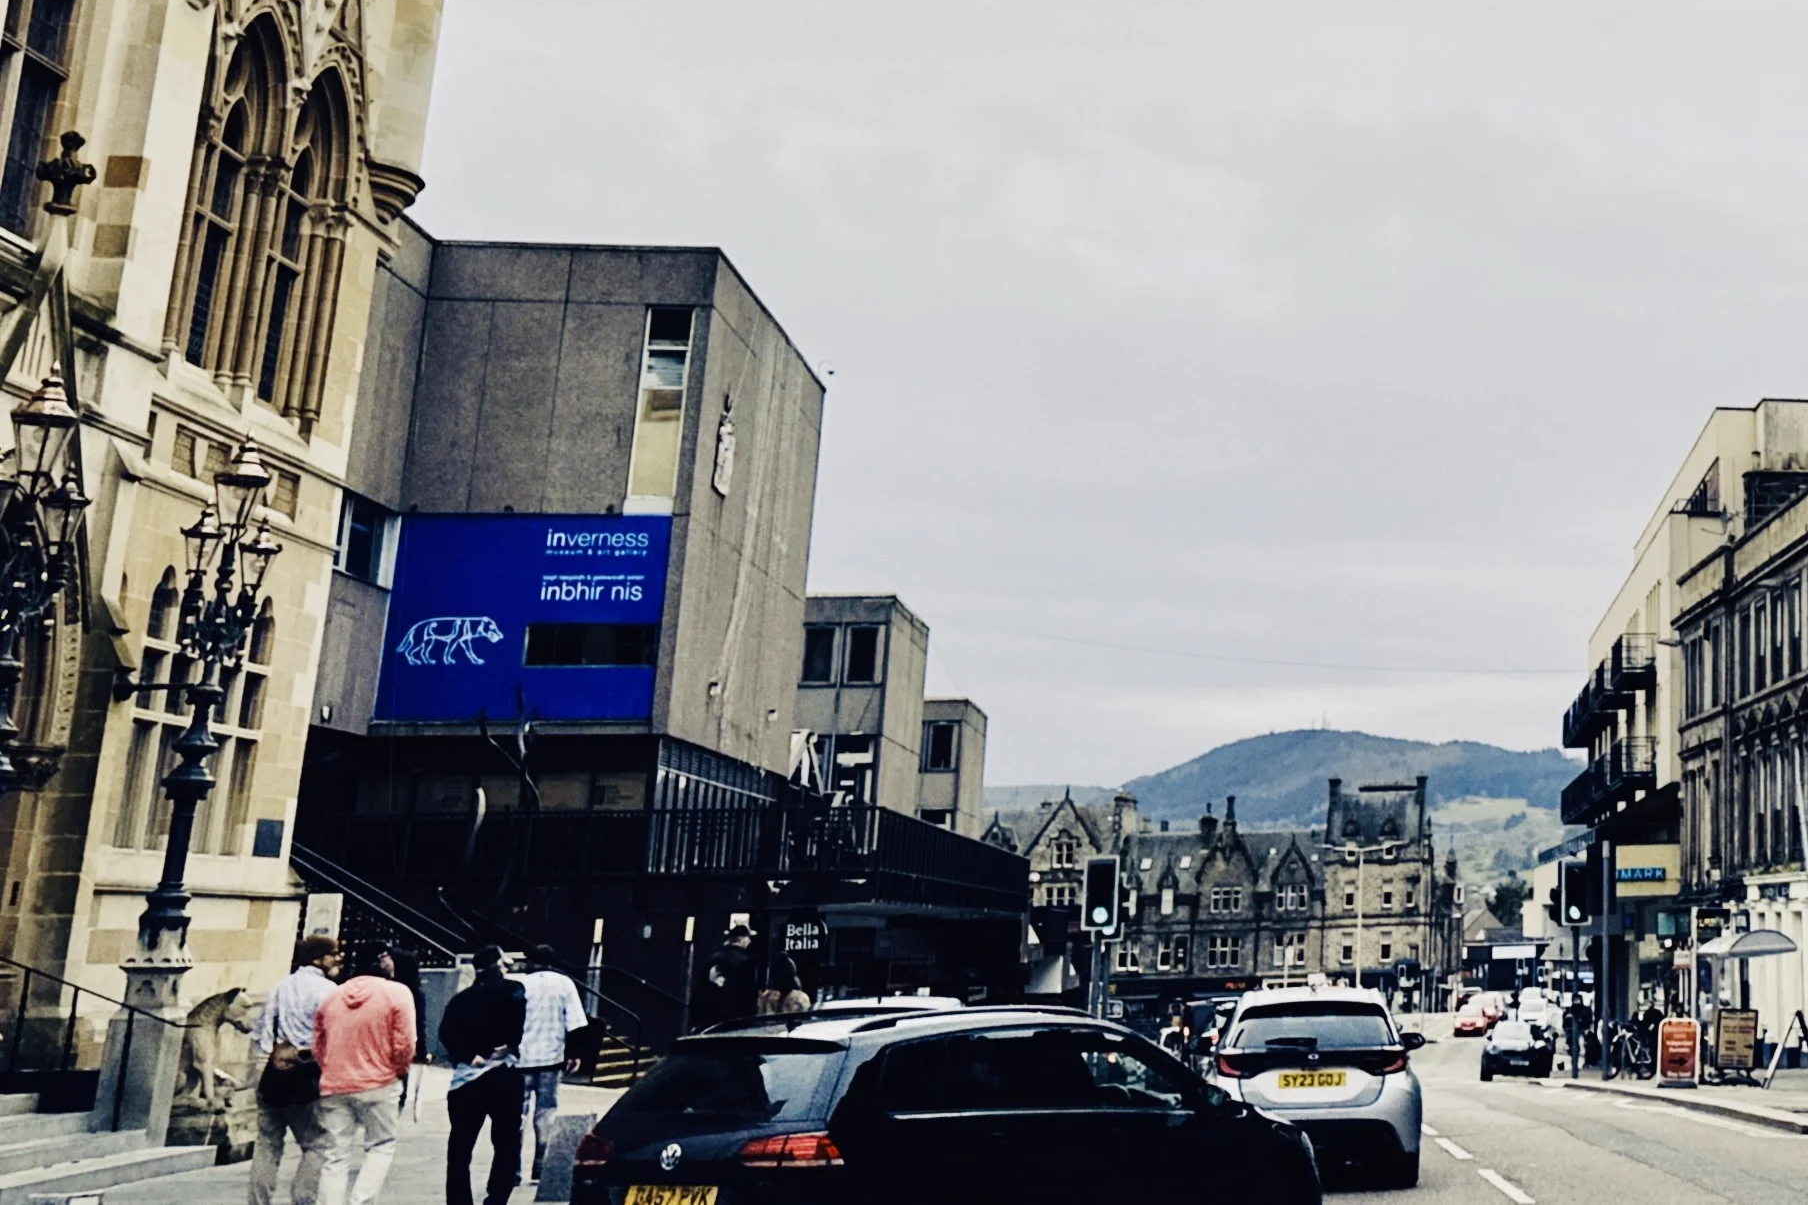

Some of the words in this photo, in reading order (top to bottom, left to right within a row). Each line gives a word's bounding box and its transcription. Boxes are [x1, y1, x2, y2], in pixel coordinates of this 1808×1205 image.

[546, 528, 649, 547] inverness
[540, 581, 605, 601] inbhir
[611, 581, 643, 601] nis
[786, 922, 819, 936] Bella
[785, 936, 819, 951] Italia
[1283, 1074, 1315, 1087] SY23
